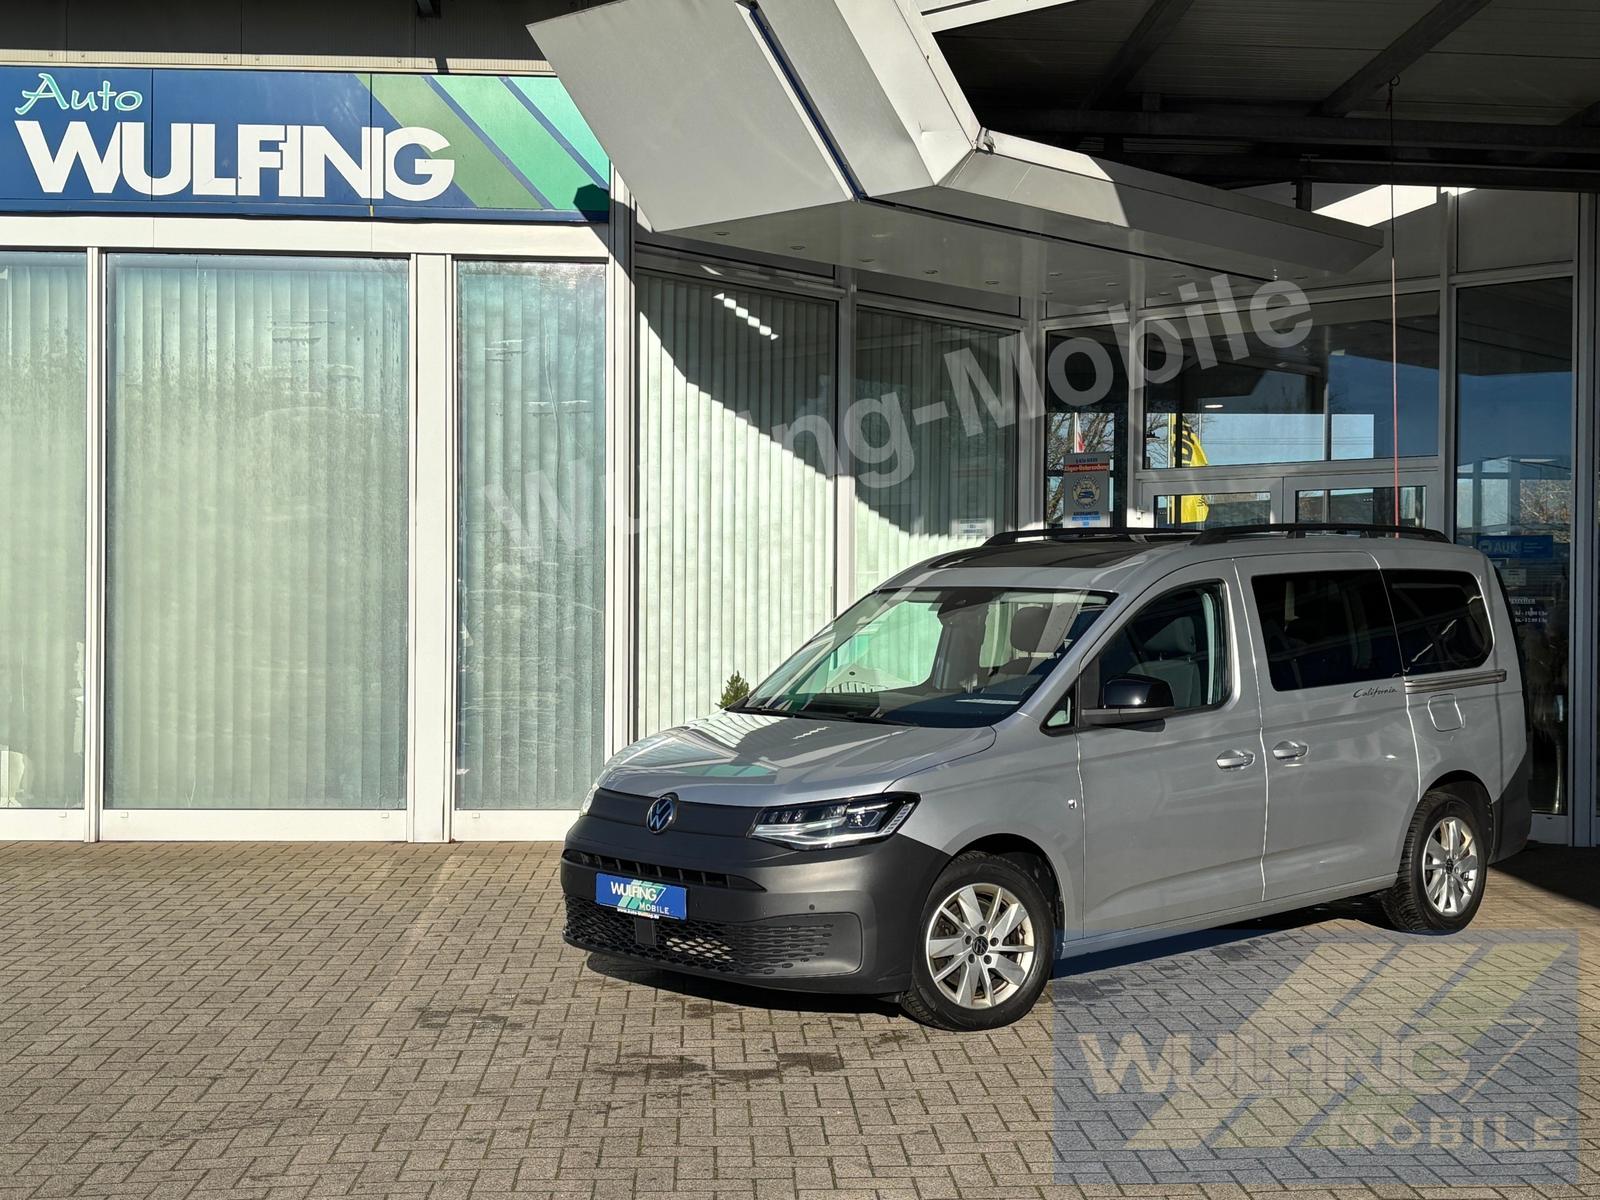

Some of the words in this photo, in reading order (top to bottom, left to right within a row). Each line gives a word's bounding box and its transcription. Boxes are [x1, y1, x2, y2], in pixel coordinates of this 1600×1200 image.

[15, 73, 143, 115] Auto
[14, 120, 455, 201] WULFING
[1352, 686, 1397, 698] California
[610, 881, 657, 901] WULFING
[639, 901, 670, 915] MOBILE
